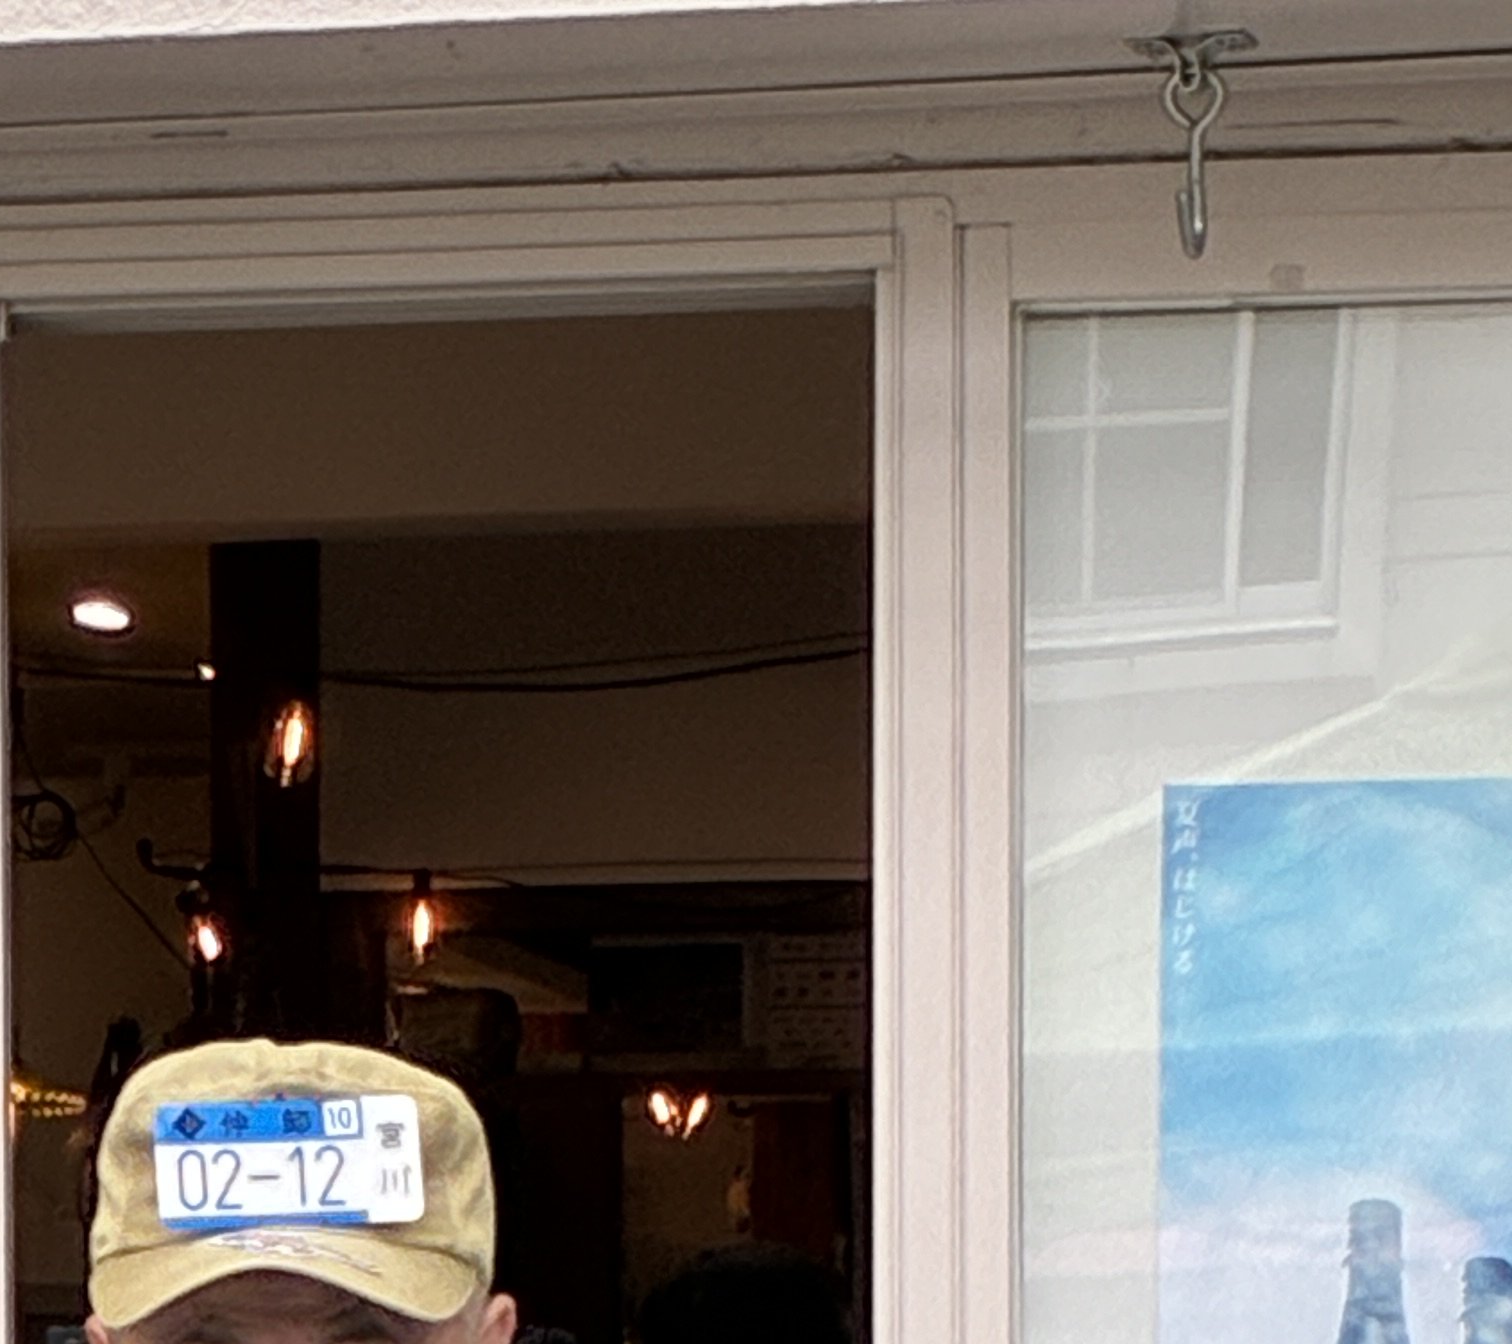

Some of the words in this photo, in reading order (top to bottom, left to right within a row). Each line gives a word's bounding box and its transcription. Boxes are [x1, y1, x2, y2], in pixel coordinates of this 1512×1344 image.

[327, 1107, 352, 1129] 10
[176, 1145, 347, 1211] 02-12
[375, 1121, 412, 1196] 宮川
